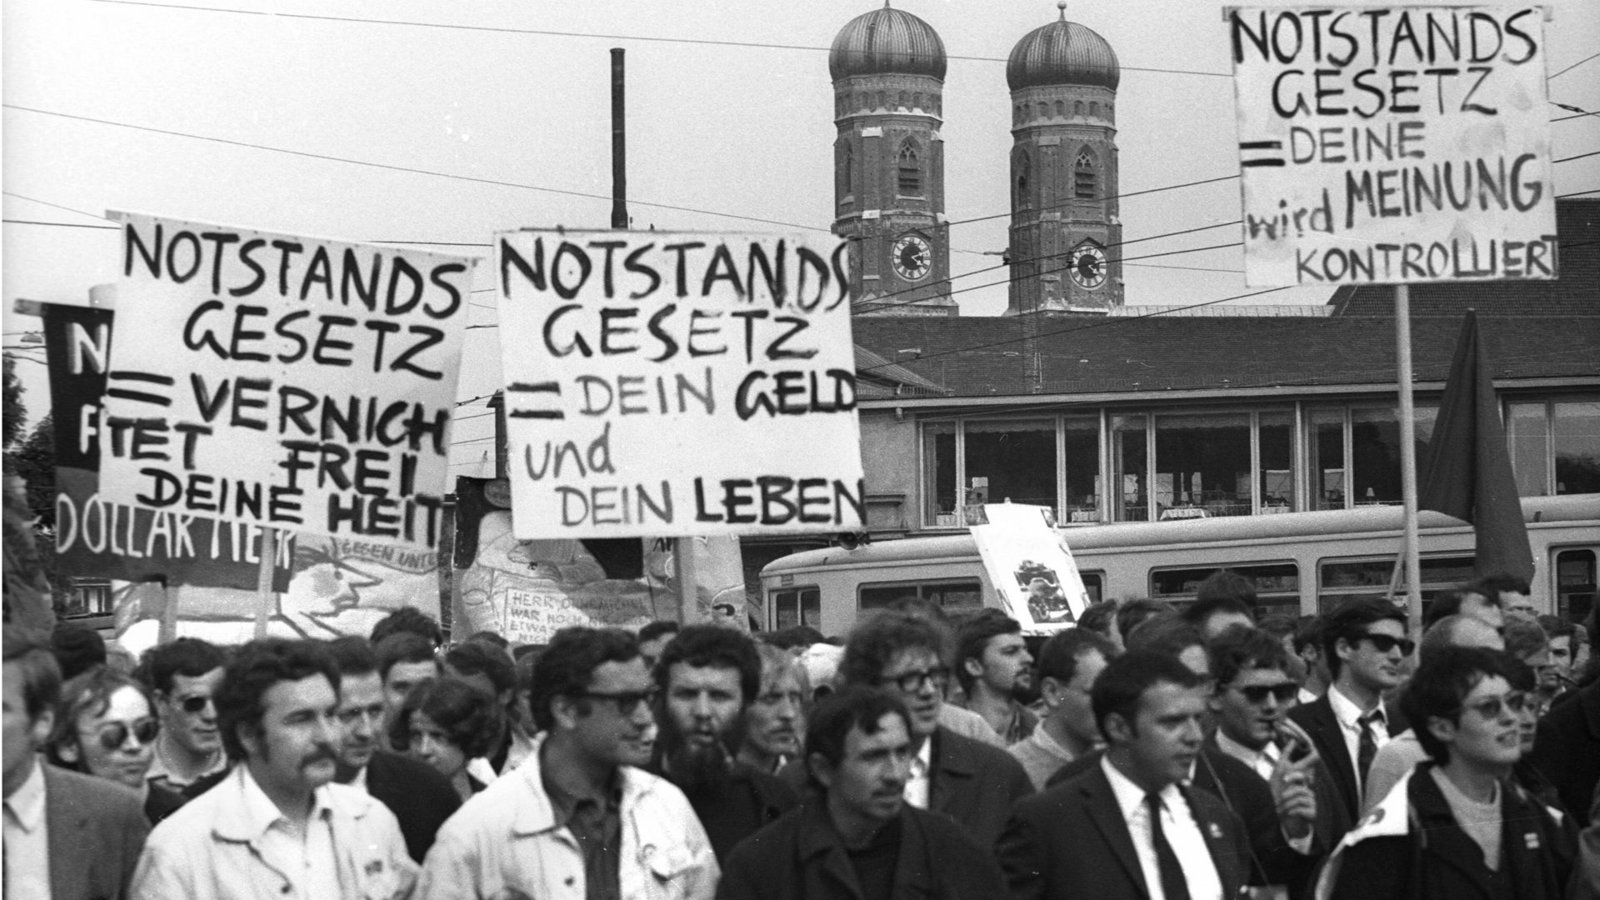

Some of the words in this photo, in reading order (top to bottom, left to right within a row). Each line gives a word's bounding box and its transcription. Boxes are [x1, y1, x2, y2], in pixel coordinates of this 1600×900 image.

[1231, 9, 1537, 67] NOTSTANDS
[1272, 66, 1497, 119] GESETZ
[1290, 121, 1425, 165] DEINE
[1248, 188, 1334, 240] wird
[1346, 153, 1543, 230] MEINUNG
[125, 223, 467, 319] NOTSTANDS
[501, 237, 850, 312] NOTSTANDS
[183, 300, 445, 380] GESETZ
[543, 303, 819, 364] GESETZ
[190, 373, 449, 456] VERNICH
[575, 367, 716, 417] DEIN
[734, 368, 858, 420] GELD
[107, 417, 213, 470] TET
[278, 441, 417, 498] FREI
[525, 422, 615, 480] und
[137, 468, 303, 524] DEINE
[327, 493, 444, 548] HEIT
[554, 480, 674, 527] DEIN
[694, 476, 868, 526] LEBEN
[511, 608, 540, 622] WAR
[513, 592, 554, 609] HERR
